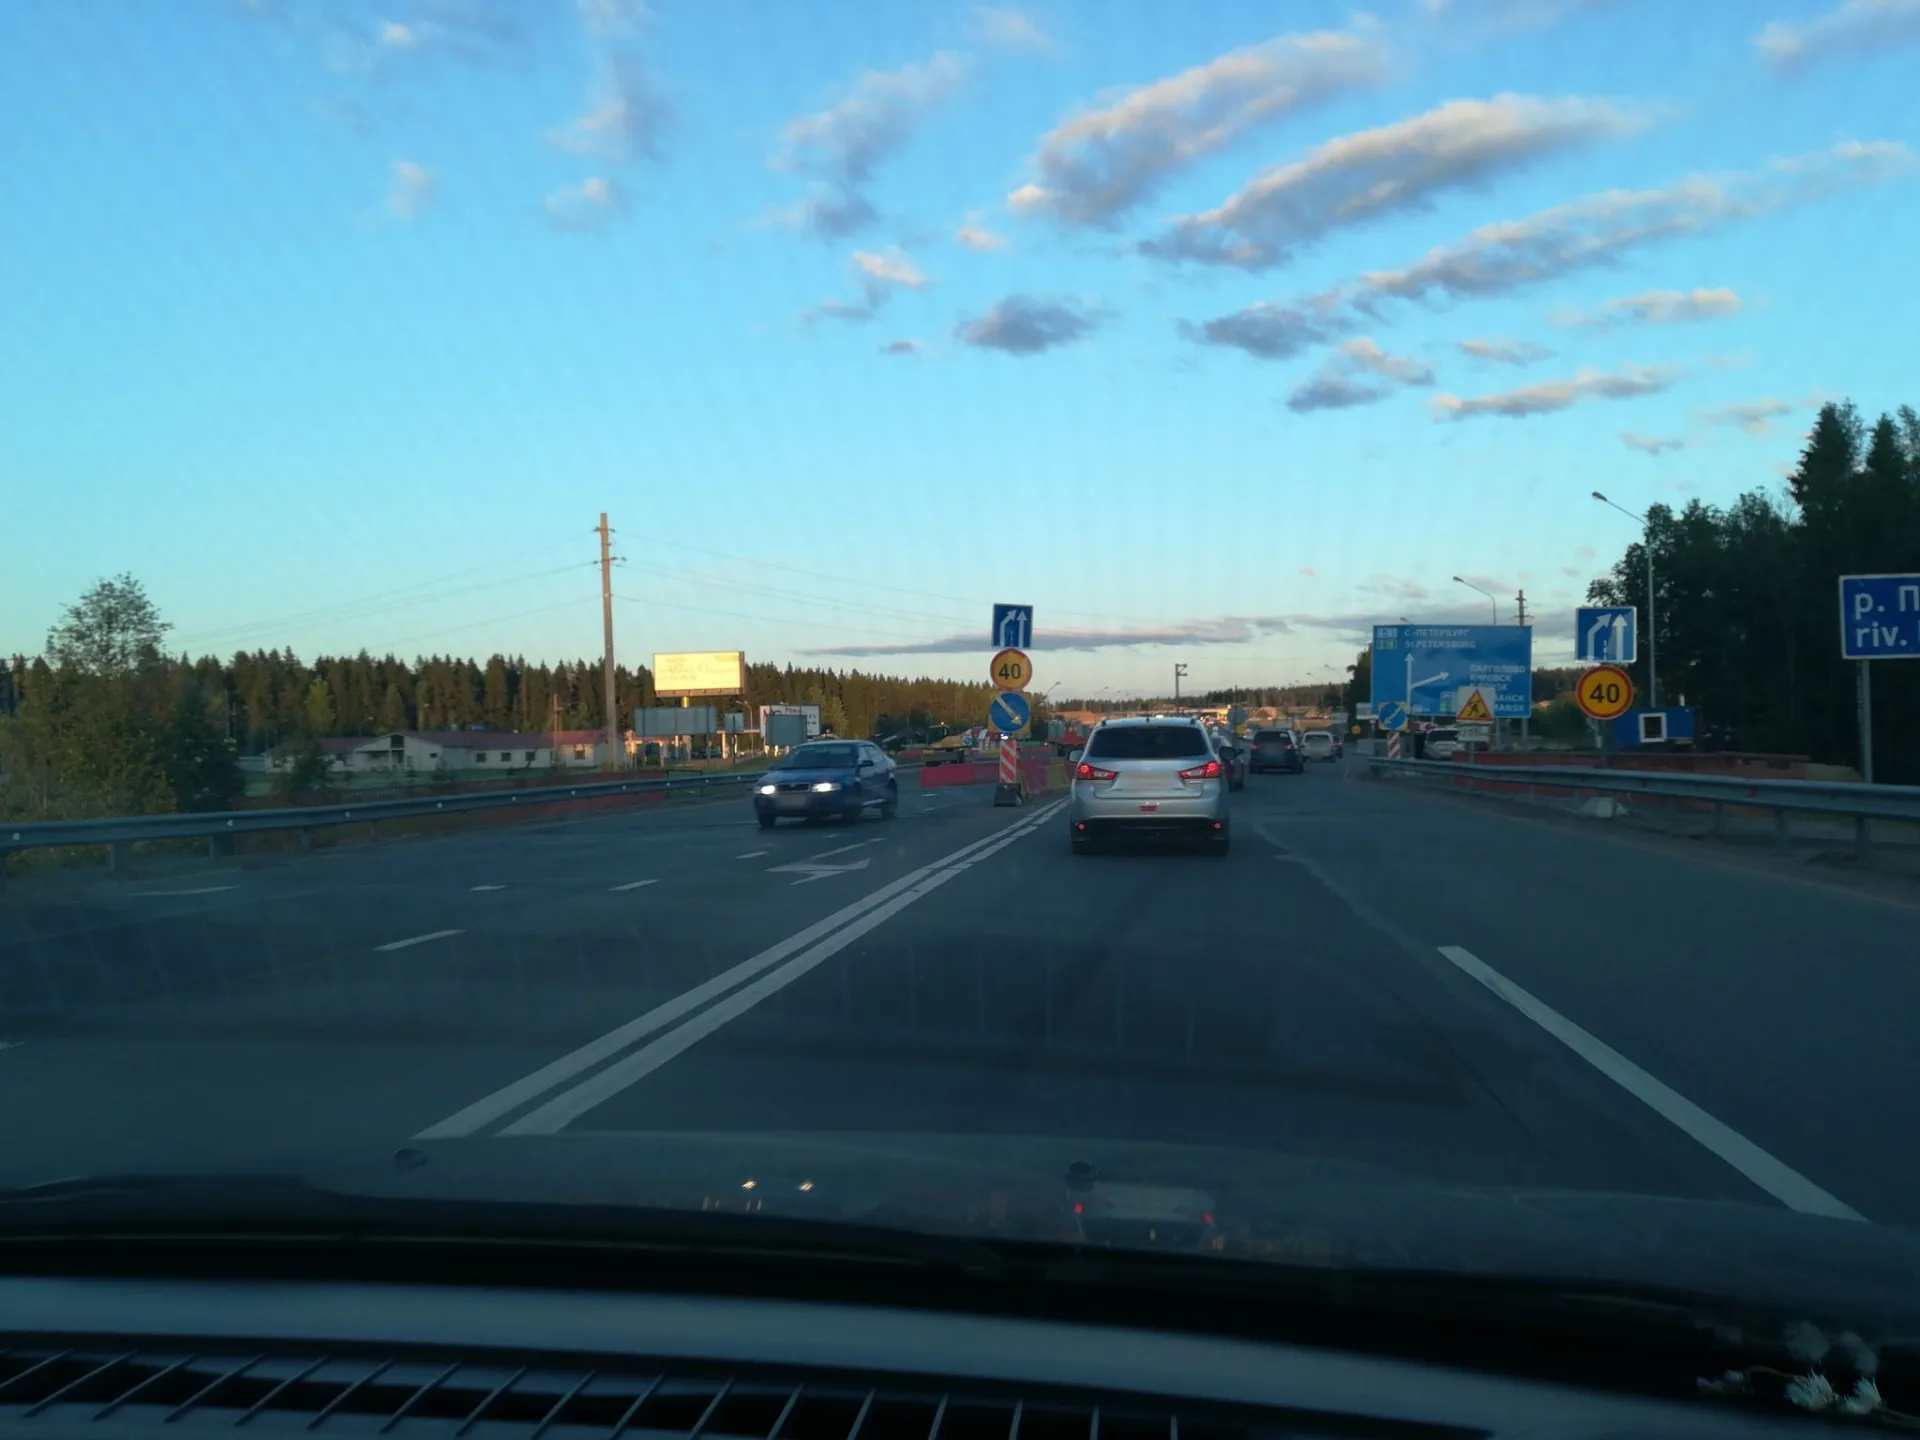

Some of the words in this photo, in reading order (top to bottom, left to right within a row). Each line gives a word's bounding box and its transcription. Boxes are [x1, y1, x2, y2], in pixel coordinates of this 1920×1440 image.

[1855, 592, 1885, 620] р.
[1856, 620, 1908, 648] riv.
[998, 663, 1021, 680] 40
[1590, 683, 1620, 703] 40
